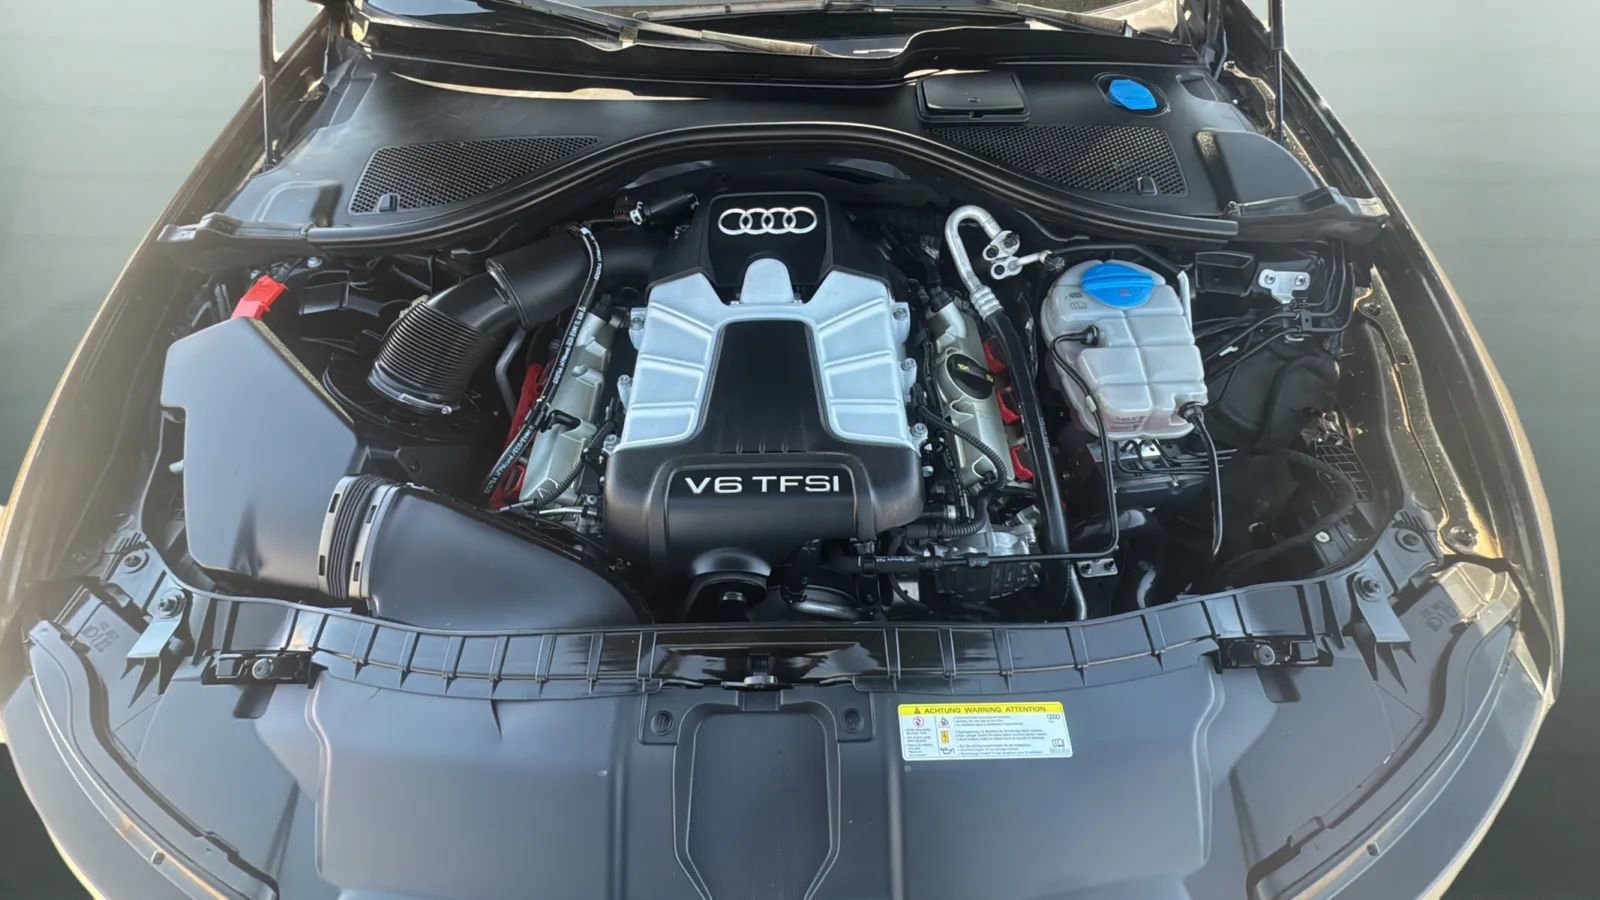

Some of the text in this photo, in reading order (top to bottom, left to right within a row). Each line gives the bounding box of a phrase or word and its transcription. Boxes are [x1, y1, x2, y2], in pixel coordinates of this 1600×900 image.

[684, 475, 839, 494] V6 TFSI
[924, 705, 1046, 715] ACHTUNG WARNING ATTENTION
